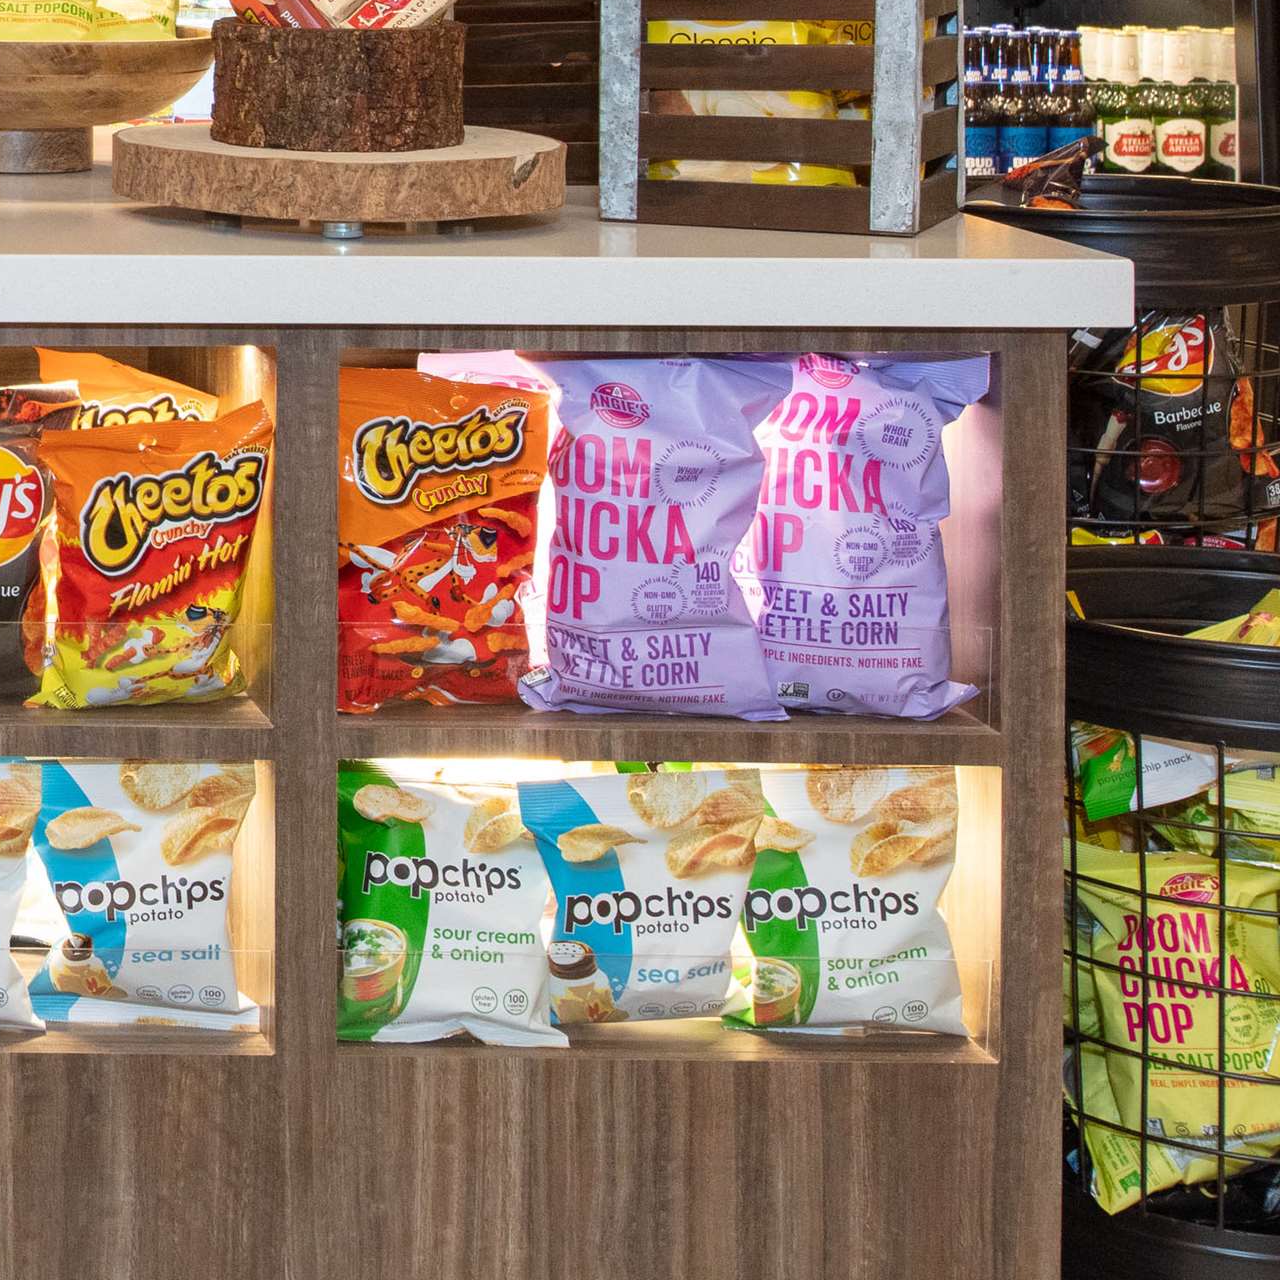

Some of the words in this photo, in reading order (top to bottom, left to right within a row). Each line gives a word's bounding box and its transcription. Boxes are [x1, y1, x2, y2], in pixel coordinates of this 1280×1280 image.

[34, 2, 94, 23] POPCORN
[1168, 136, 1200, 146] STELLA
[965, 157, 993, 168] BUD
[590, 391, 651, 422] ANGIE'S
[881, 433, 910, 448] GRAIN
[882, 423, 915, 439] WHOLE
[360, 411, 520, 496] Cheetos
[413, 473, 488, 512] Crunchy
[88, 454, 261, 568] Cheetos
[150, 521, 213, 549] Crunchy
[196, 533, 249, 571] Hot
[845, 542, 878, 551] NON-GMO
[848, 556, 874, 564] GLUTEN
[694, 561, 721, 583] 140
[646, 604, 673, 613] GLUTEN
[820, 592, 839, 617] &
[848, 592, 909, 619] SALTY
[841, 620, 899, 646] CORN
[621, 636, 639, 660] &
[647, 631, 712, 659] SALTY
[788, 650, 855, 668] INGREDIENTS.
[857, 657, 899, 669] NOTHING
[901, 657, 924, 669] FAKE.
[640, 660, 700, 687] CORN
[657, 693, 700, 705] NOTHING
[702, 693, 729, 705] FAKE.
[1163, 752, 1193, 767] snack
[362, 851, 522, 899] popchips
[55, 874, 225, 922] popchips
[434, 888, 486, 904] potato
[129, 908, 184, 925] potato
[565, 886, 733, 934] popchips
[745, 883, 920, 932] popchips
[636, 919, 690, 937] potato
[822, 916, 878, 933] potato
[432, 927, 474, 944] sour
[476, 929, 536, 945] cream
[131, 948, 173, 963] sea
[177, 945, 221, 962] salt
[431, 945, 443, 960] &
[449, 946, 504, 964] onion
[827, 957, 865, 973] sour
[868, 945, 928, 970] cream
[637, 966, 680, 984] sea
[686, 960, 727, 981] salt
[827, 976, 840, 992] &
[845, 968, 900, 990] onion
[508, 994, 525, 1004] 100
[906, 1003, 924, 1014] 100
[1123, 1001, 1195, 1045] POP
